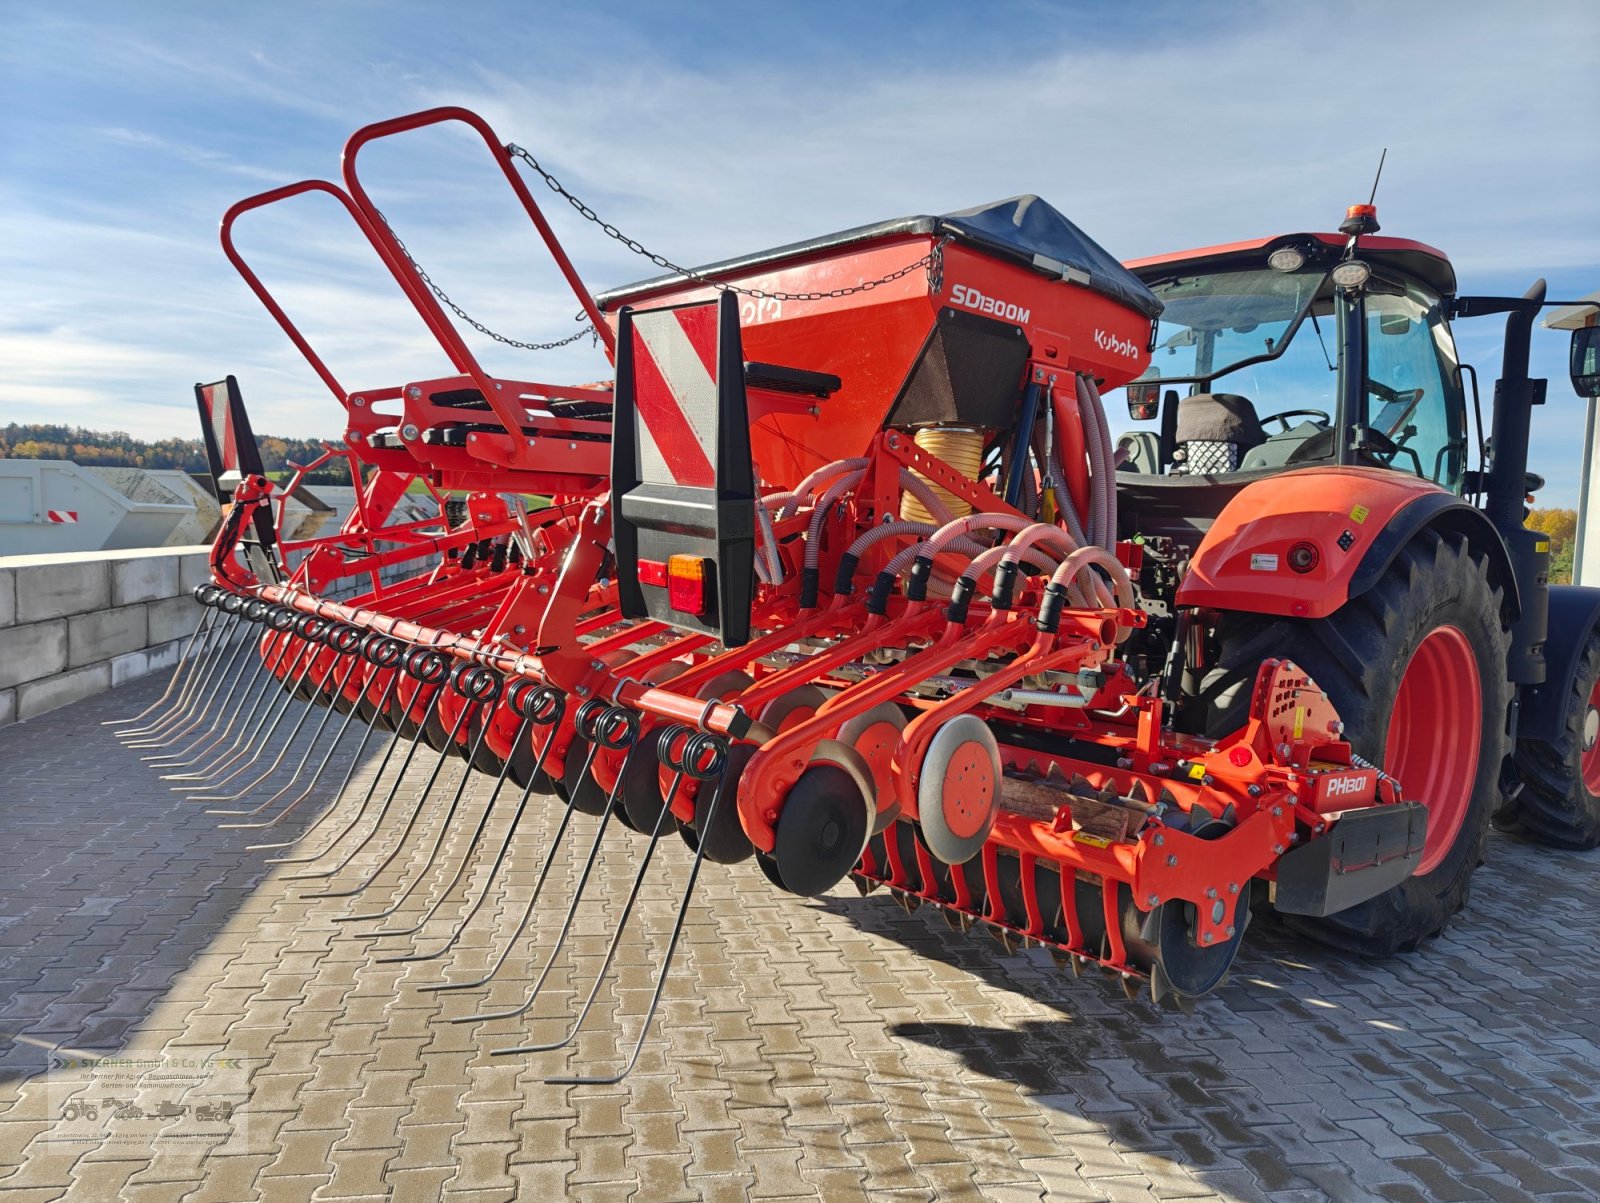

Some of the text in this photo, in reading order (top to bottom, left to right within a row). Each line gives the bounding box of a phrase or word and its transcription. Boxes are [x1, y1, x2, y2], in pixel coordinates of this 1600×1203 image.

[741, 292, 782, 324] ota
[949, 283, 1031, 324] SD1300M
[1093, 328, 1139, 360] Kubota
[1326, 776, 1367, 798] PH1301
